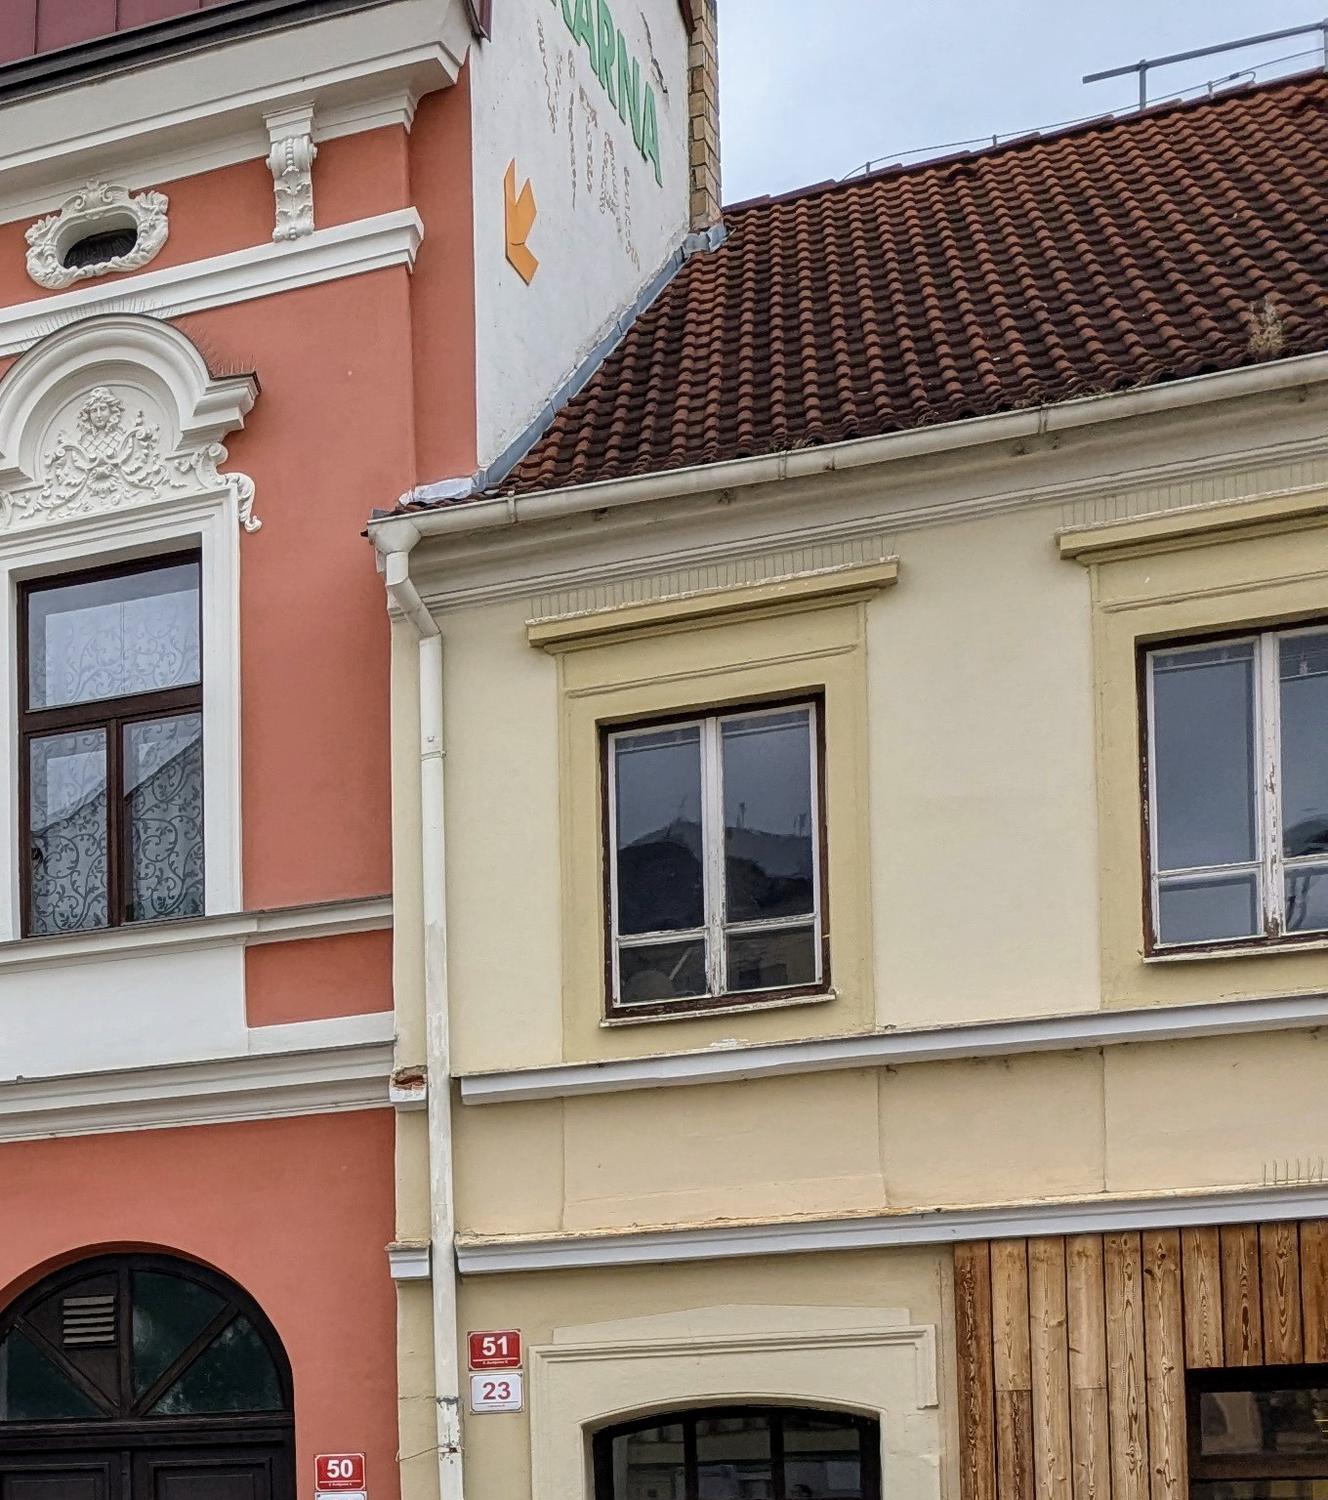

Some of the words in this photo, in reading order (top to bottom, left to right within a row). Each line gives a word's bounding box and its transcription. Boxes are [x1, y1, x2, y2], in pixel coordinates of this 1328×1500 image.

[482, 1336, 508, 1355] 51
[483, 1382, 511, 1400] 23
[327, 1459, 353, 1478] 50
